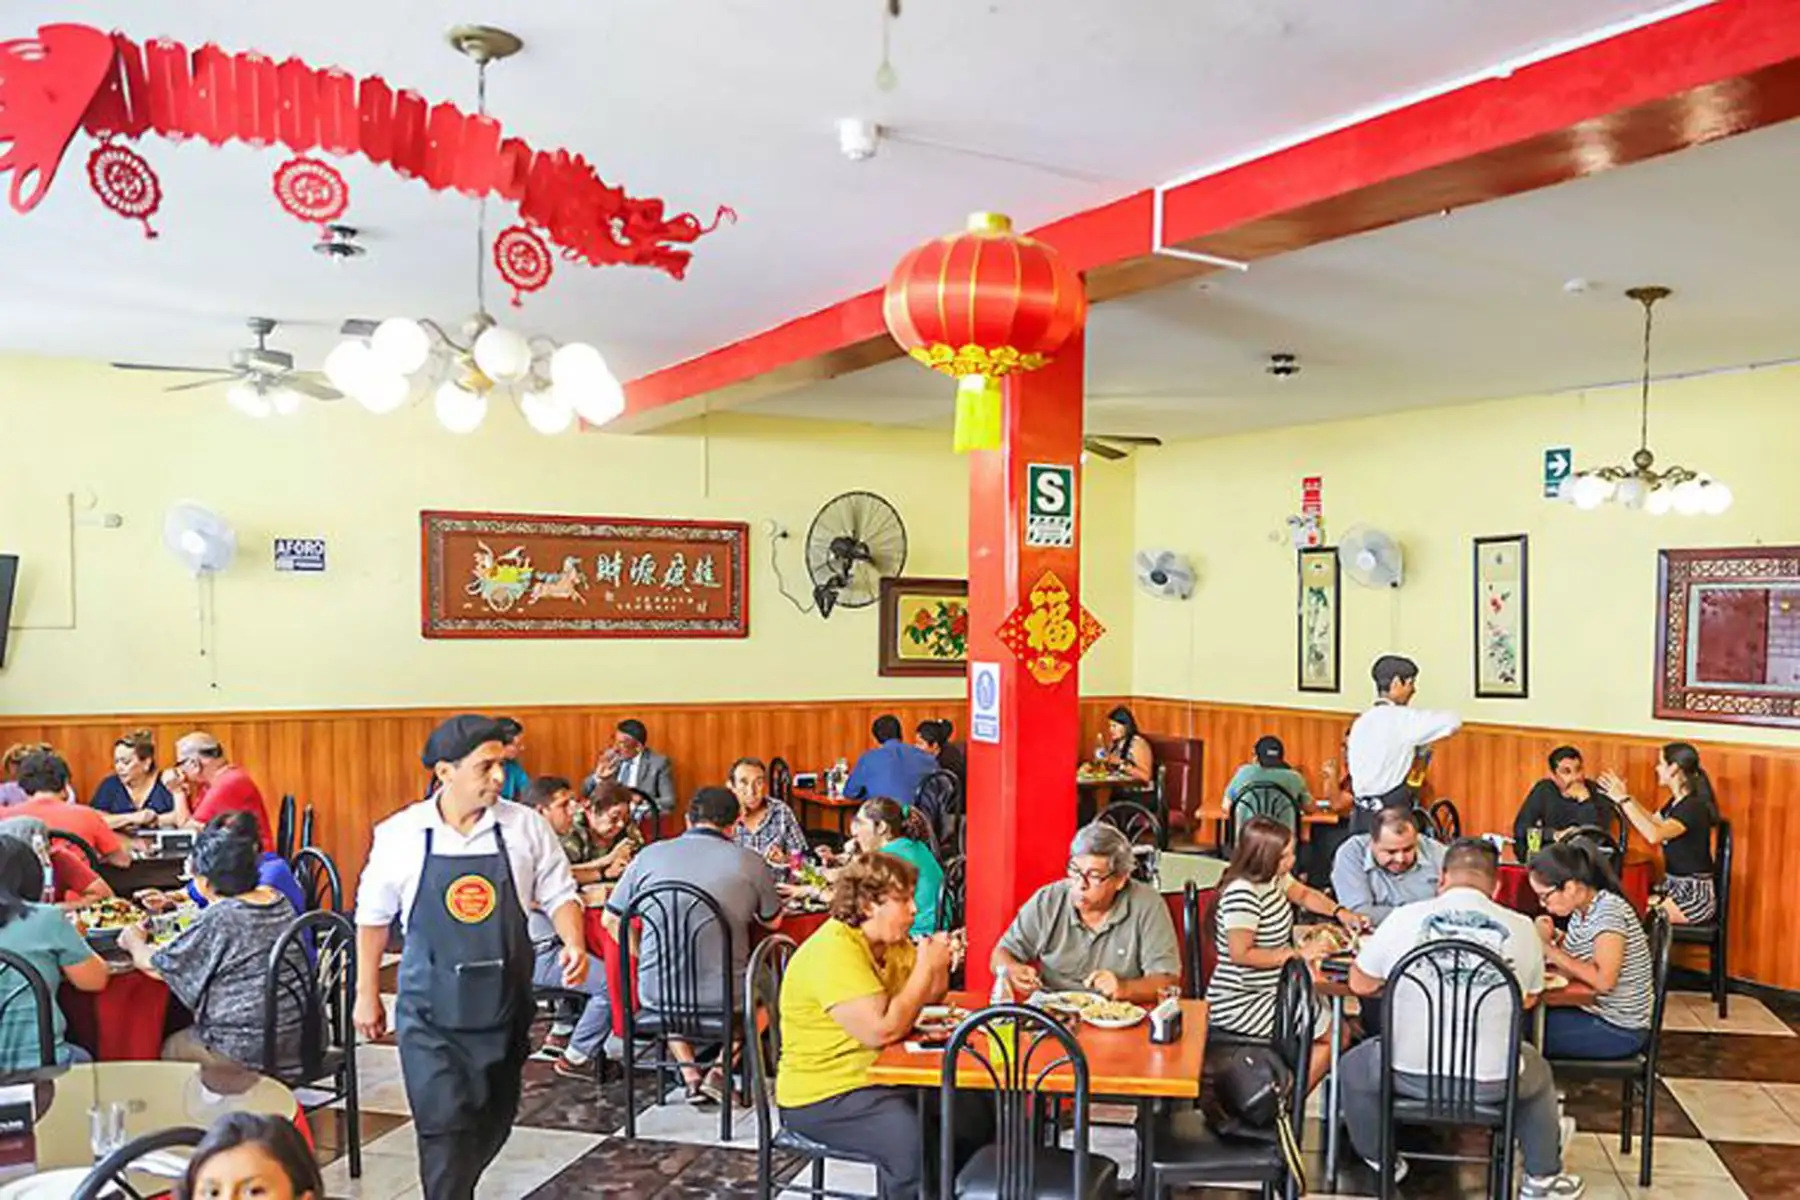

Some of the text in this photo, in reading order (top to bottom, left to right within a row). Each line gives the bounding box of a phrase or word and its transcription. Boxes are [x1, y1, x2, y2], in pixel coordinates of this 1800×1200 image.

[1036, 471, 1065, 512] S
[277, 540, 323, 555] AFORO
[1024, 590, 1077, 652] 福
